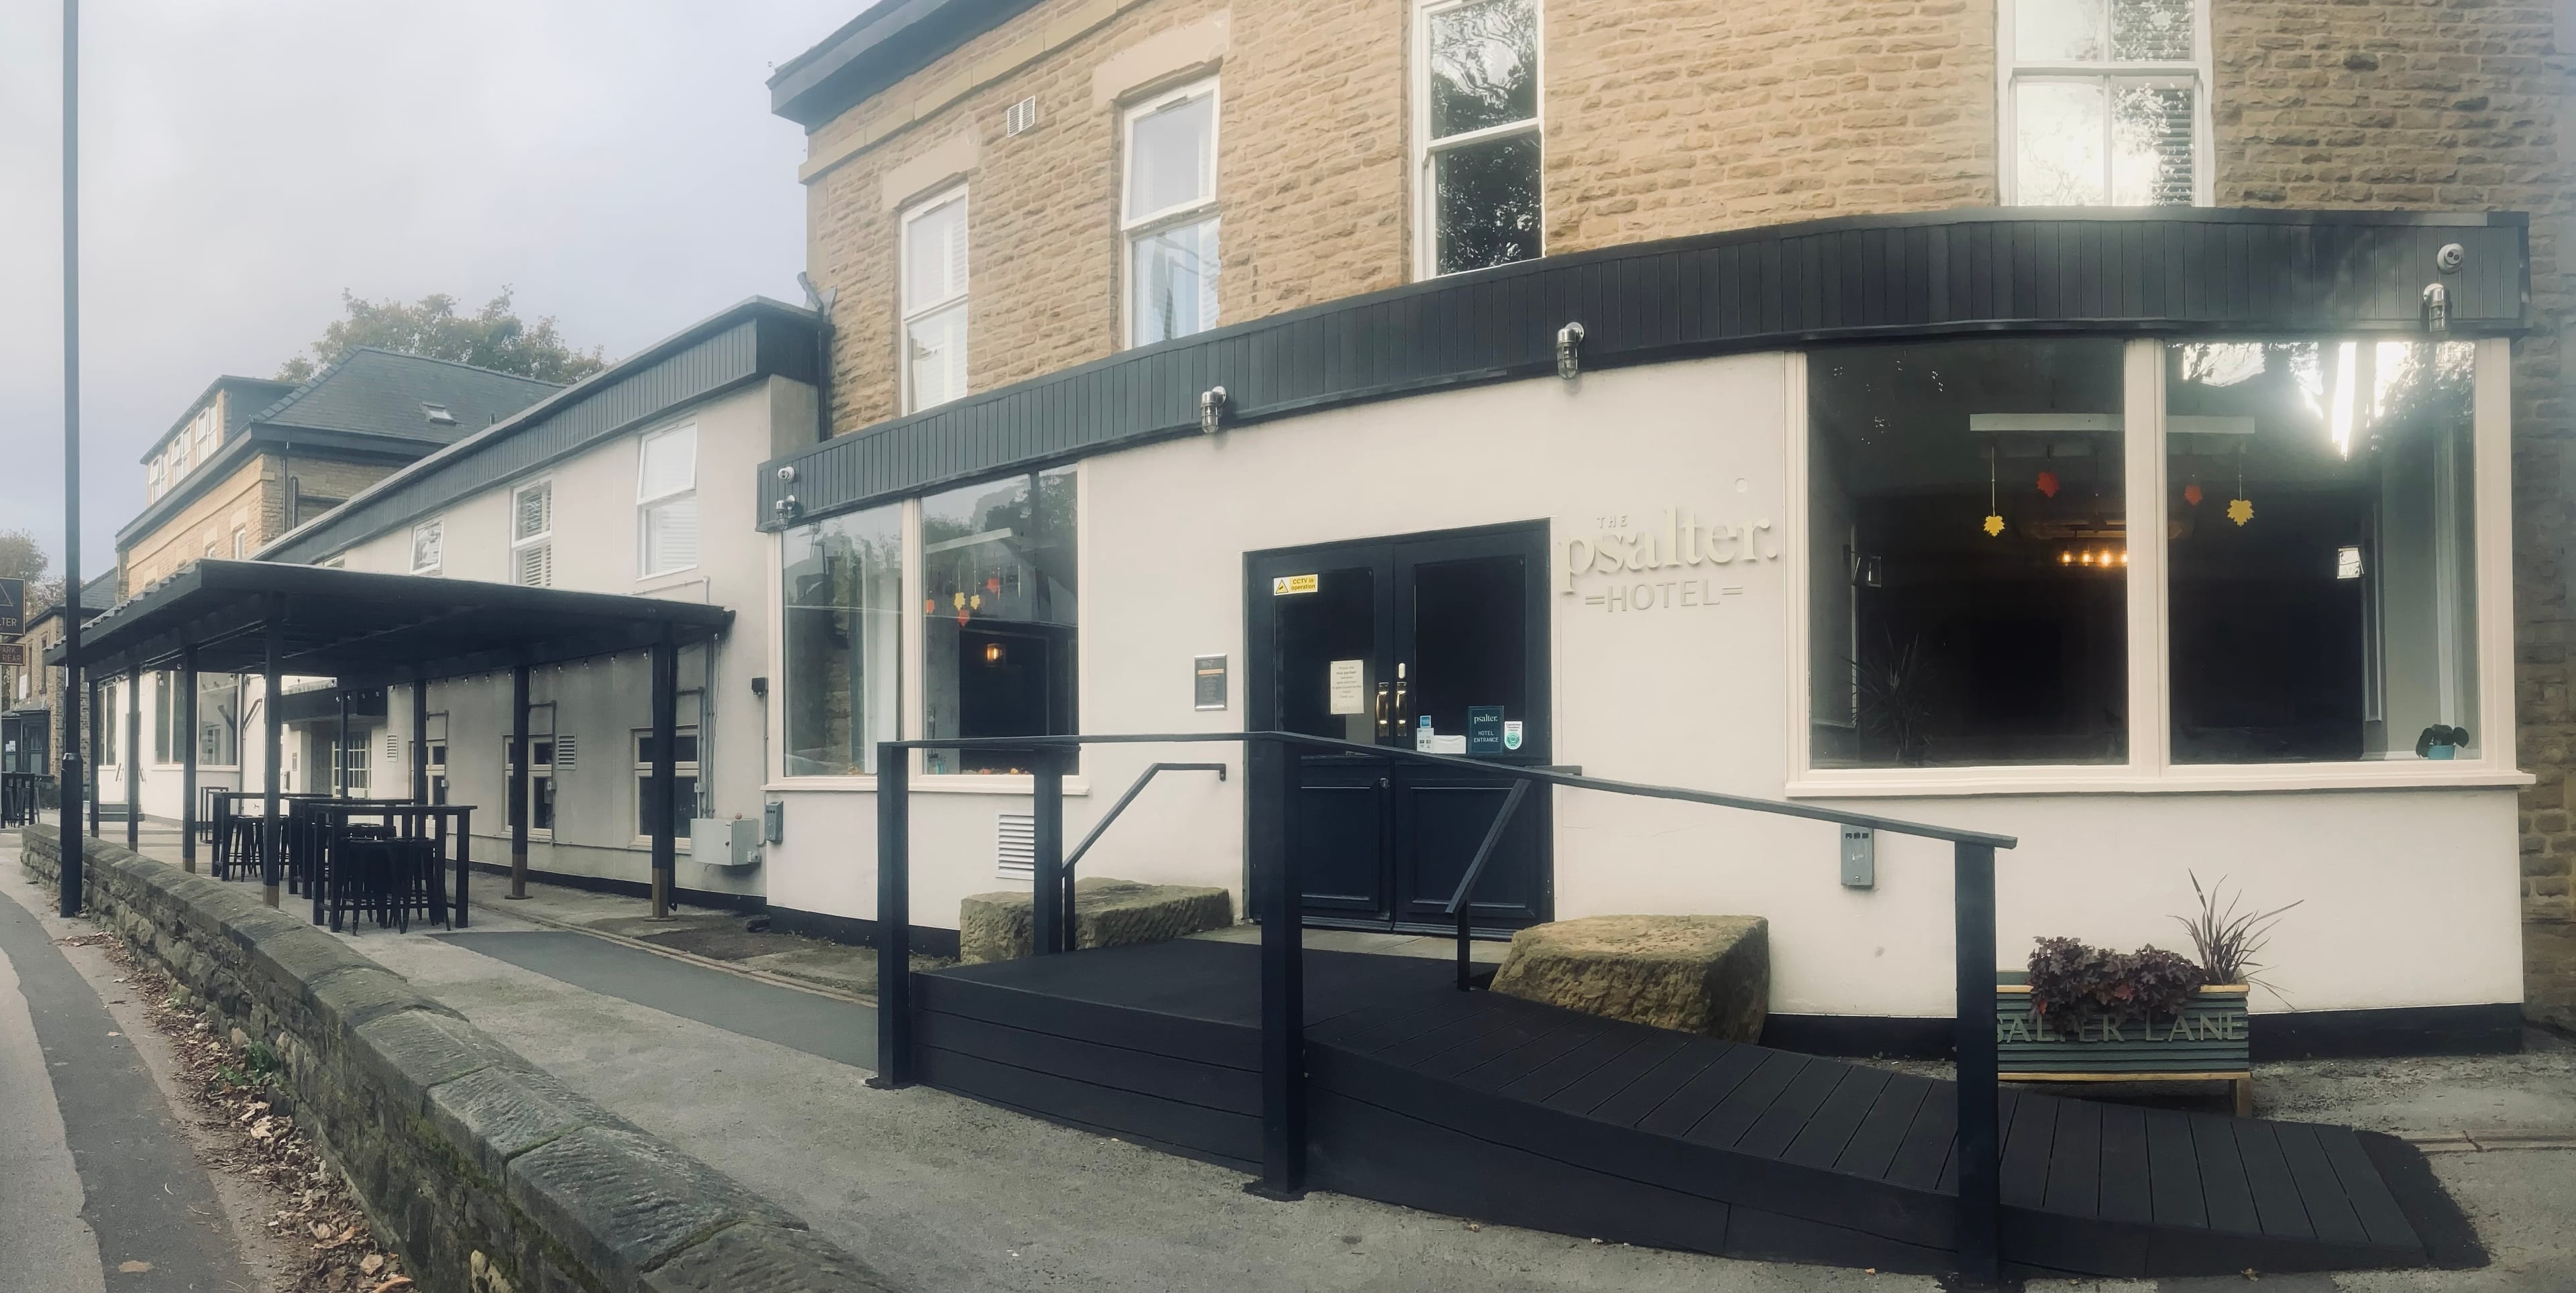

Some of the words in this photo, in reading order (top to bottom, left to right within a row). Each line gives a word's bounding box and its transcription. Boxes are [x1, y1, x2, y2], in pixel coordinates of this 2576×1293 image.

[1597, 515, 1628, 528] THE
[1558, 506, 1778, 596] psalter.
[1608, 579, 1721, 612] HOTEL
[0, 617, 17, 626] TER
[0, 646, 16, 654] ARK
[3, 654, 21, 663] REAR
[1474, 714, 1498, 724] psalter.
[2145, 1011, 2246, 1042] LANE
